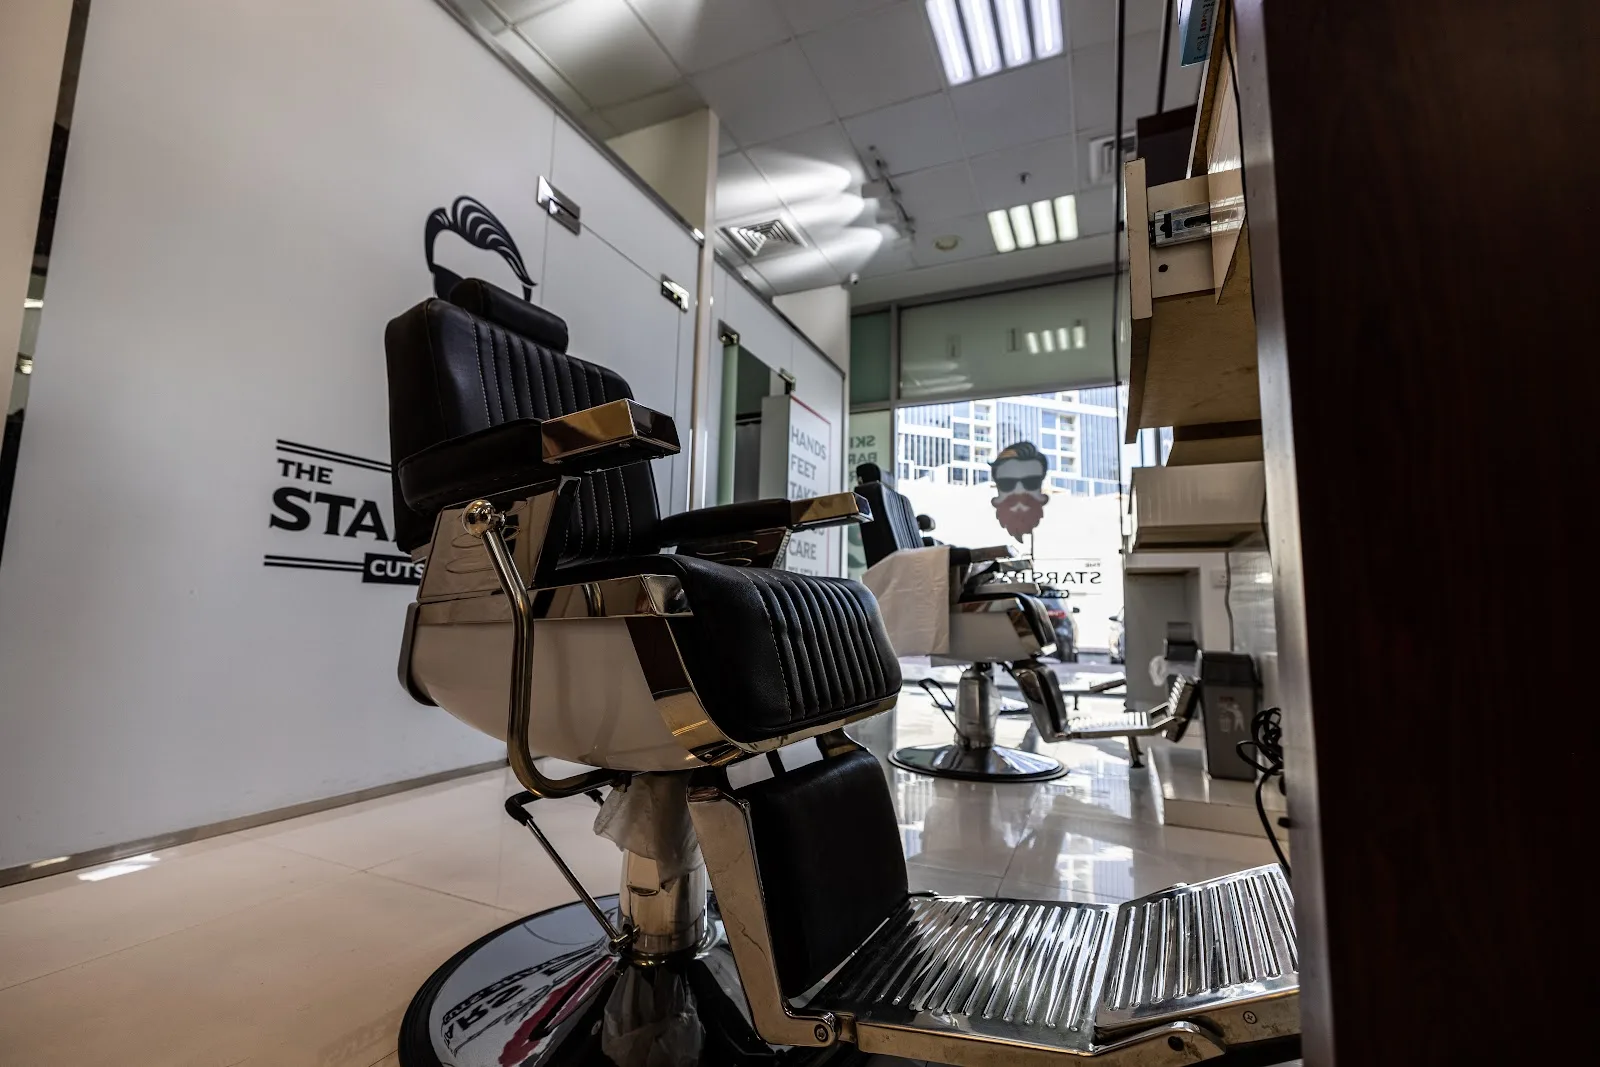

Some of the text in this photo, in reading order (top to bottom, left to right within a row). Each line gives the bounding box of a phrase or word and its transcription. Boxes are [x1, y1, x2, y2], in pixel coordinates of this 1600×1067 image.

[791, 423, 827, 461] HANDS
[277, 458, 333, 485] THE
[791, 454, 817, 481] FEET
[269, 486, 396, 542] STA
[789, 538, 817, 560] CARE
[370, 559, 425, 578] CUTS
